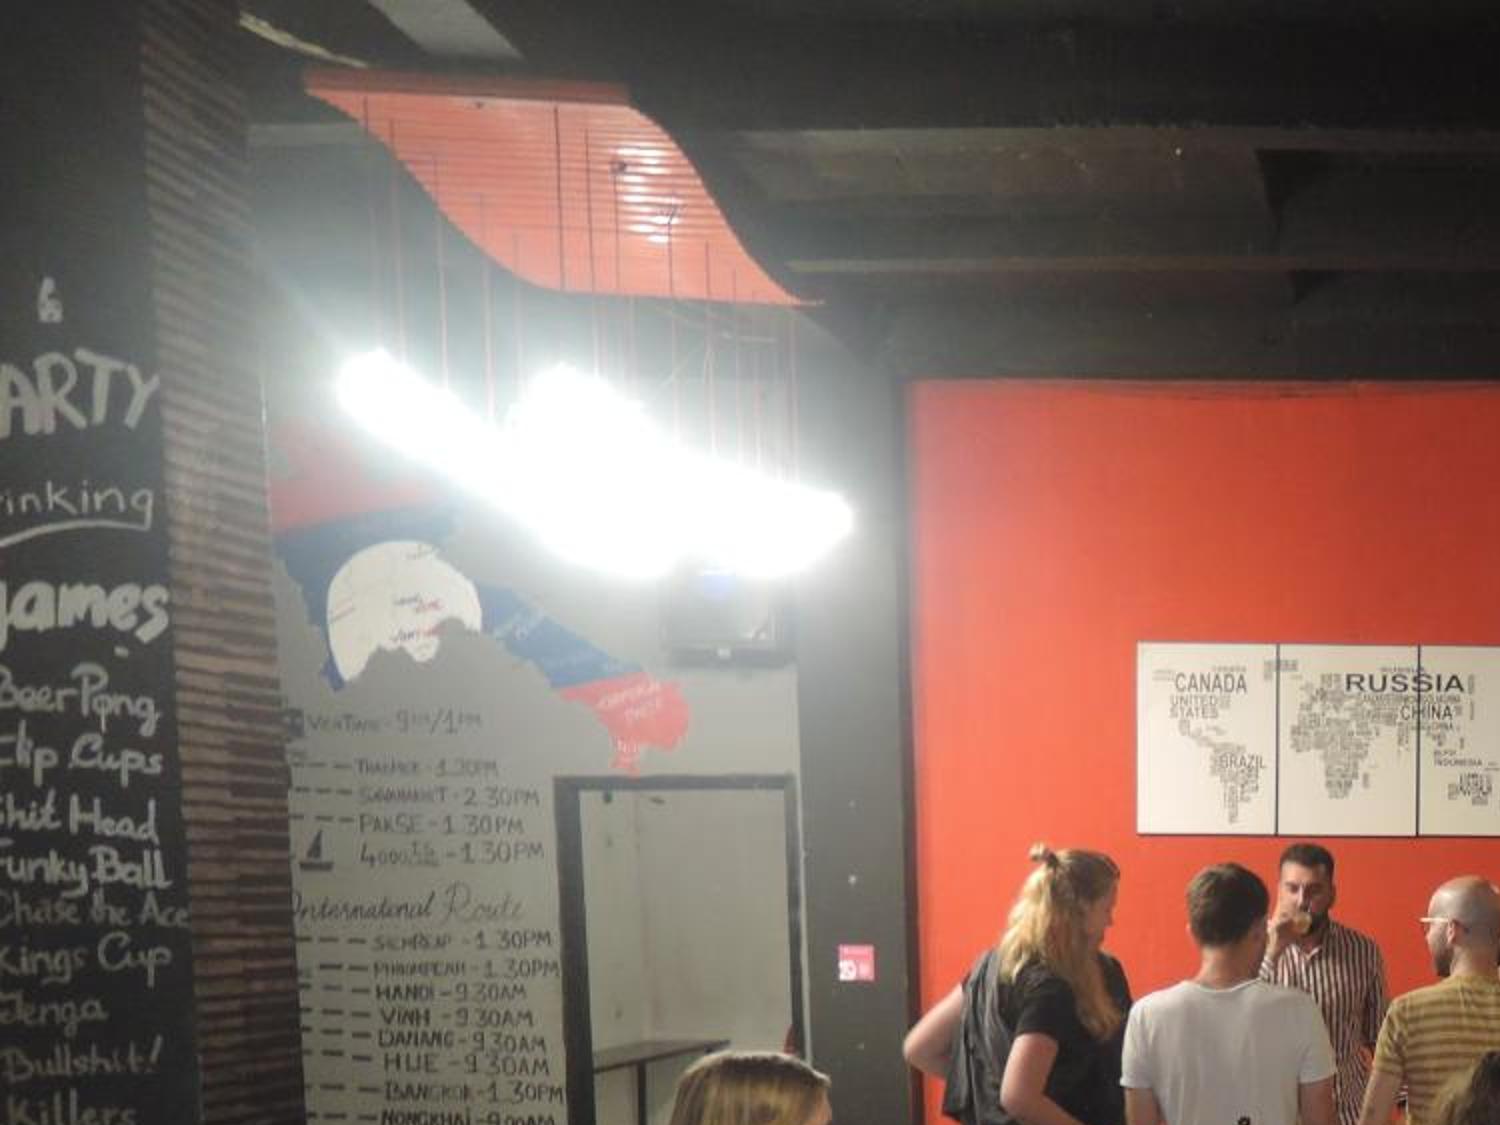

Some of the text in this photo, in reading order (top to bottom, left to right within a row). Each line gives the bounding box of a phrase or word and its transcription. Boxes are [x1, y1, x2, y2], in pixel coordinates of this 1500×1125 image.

[1175, 673, 1247, 692] CANADA
[1345, 673, 1464, 692] RUSSIA
[70, 661, 162, 737] Pong
[1401, 704, 1453, 720] CHINA
[70, 732, 163, 788] Cups
[1219, 755, 1267, 769] BRAZIL
[0, 786, 160, 845] hit Head
[88, 845, 173, 890] Ball
[90, 887, 132, 926] the
[137, 889, 192, 928] Ace
[97, 931, 172, 988] Cup
[375, 983, 434, 1001] HANOI
[384, 1052, 440, 1073] HUE
